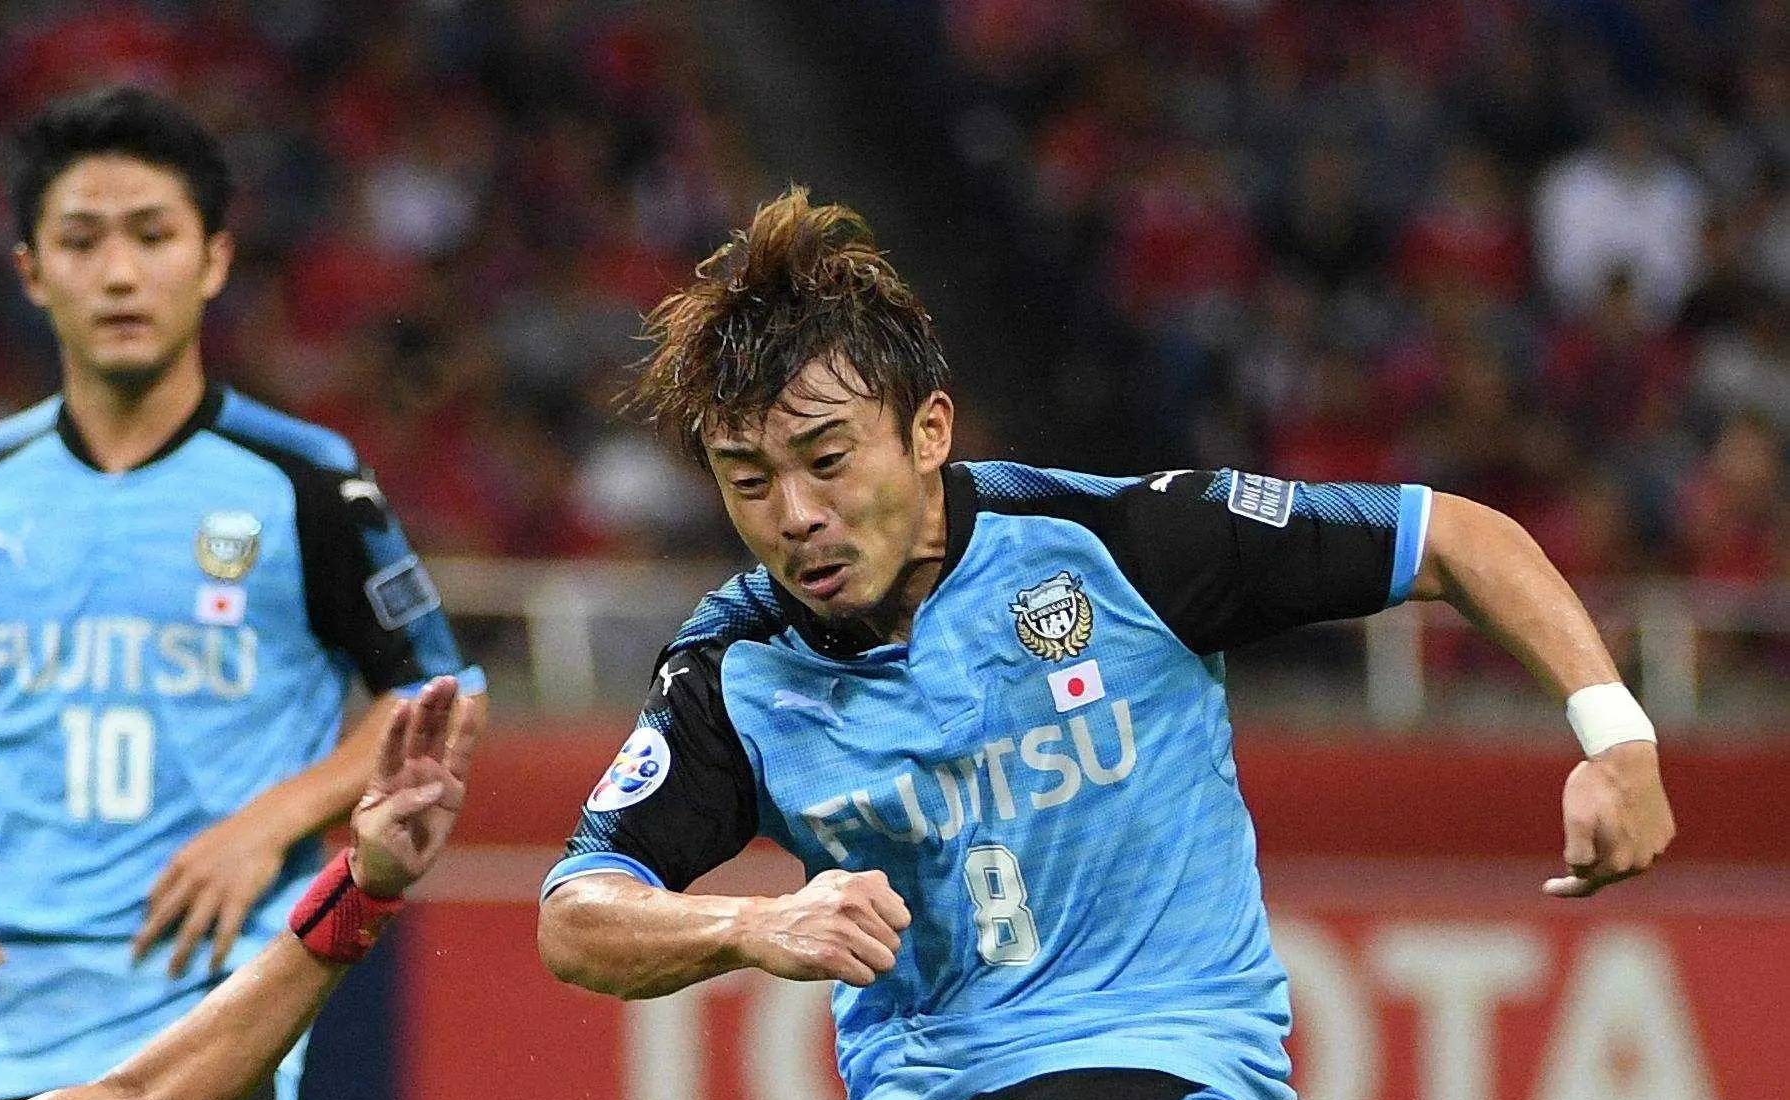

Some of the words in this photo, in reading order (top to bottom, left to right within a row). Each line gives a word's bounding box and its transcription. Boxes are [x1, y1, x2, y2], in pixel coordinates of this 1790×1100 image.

[62, 704, 153, 824] 10
[802, 698, 1137, 863] FUJITSU
[964, 844, 1041, 966] 8
